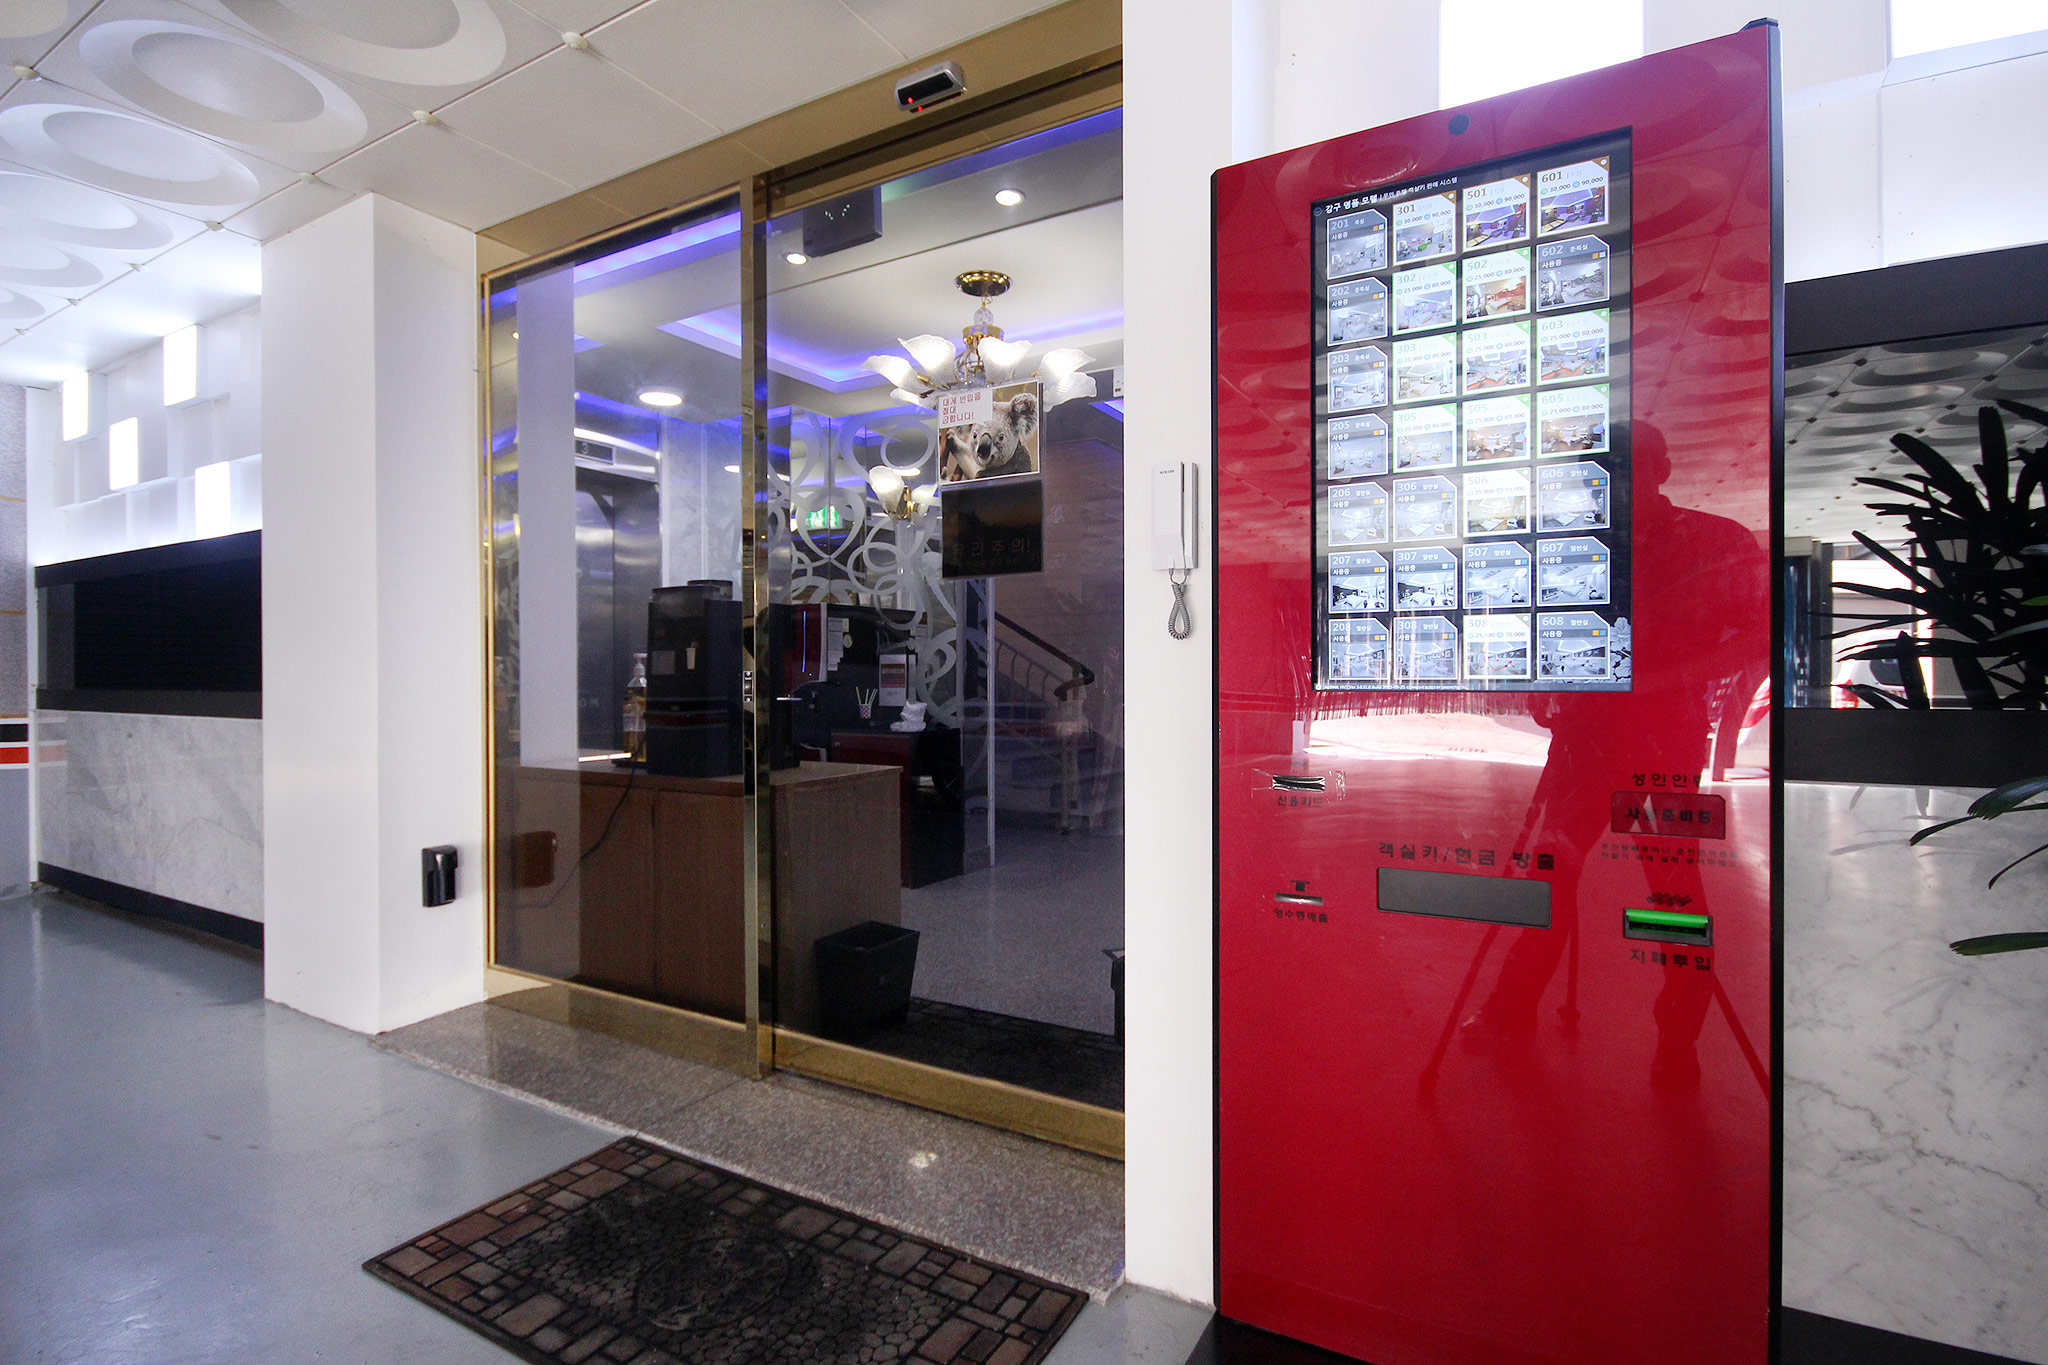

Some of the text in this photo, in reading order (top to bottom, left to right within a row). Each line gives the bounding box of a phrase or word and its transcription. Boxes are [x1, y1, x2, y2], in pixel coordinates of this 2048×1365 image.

[1541, 171, 1563, 183] 601
[1550, 176, 1604, 193] 30,000 90,000
[1325, 202, 1341, 214] 강구
[1343, 198, 1359, 210] 명품
[1361, 193, 1378, 205] 모텔
[1439, 176, 1458, 187] 시스템
[1467, 188, 1488, 200] 501
[1397, 204, 1416, 216] 301
[1331, 219, 1350, 231] 201
[1331, 231, 1348, 241] 사용중
[1541, 245, 1564, 257] 602
[1467, 259, 1488, 271] 502
[1541, 259, 1562, 269] 사용중
[1397, 273, 1416, 285] 302
[1474, 266, 1525, 281] 25,000 80,000
[1332, 286, 1350, 297] 202
[1404, 285, 1423, 293] 25,000
[1331, 298, 1348, 308] 사용중
[1542, 320, 1564, 331] 603
[1467, 332, 1488, 342] 503
[1550, 328, 1604, 342] 25,000 80,000
[1397, 343, 1416, 354] 303
[1332, 355, 1350, 365] 203
[1332, 366, 1349, 375] 사용중
[942, 392, 981, 406] 대게 반입을
[1542, 393, 1564, 405] 605
[1467, 403, 1488, 414] 505
[1550, 403, 1604, 415] 25,000 80,000
[942, 411, 974, 425] 금합니다!
[1398, 412, 1417, 423] 305
[1332, 421, 1350, 431] 205
[1332, 433, 1350, 441] 사용중
[1542, 468, 1564, 479] 606
[1397, 482, 1417, 492] 306
[1542, 482, 1562, 490] 사용중
[1332, 489, 1351, 498] 206
[1397, 494, 1416, 503] 사용중
[1332, 500, 1350, 508] 사용중
[1467, 547, 1489, 557] 507
[1542, 543, 1564, 553] 607
[1332, 556, 1351, 565] 207
[1397, 551, 1417, 562] 307
[1542, 555, 1563, 564] 사용중
[1397, 564, 1416, 572] 사용중
[1467, 560, 1487, 568] 사용중
[1332, 568, 1350, 576] 사용중
[1333, 622, 1351, 632] 208
[1398, 620, 1417, 630] 308
[1468, 619, 1488, 628] 508
[1542, 616, 1564, 627] 608
[1542, 630, 1563, 638] 사용중
[1277, 795, 1322, 808] 신용카드
[1379, 842, 1495, 866] 객실키/현금
[1631, 949, 1711, 971] 지폐투입
